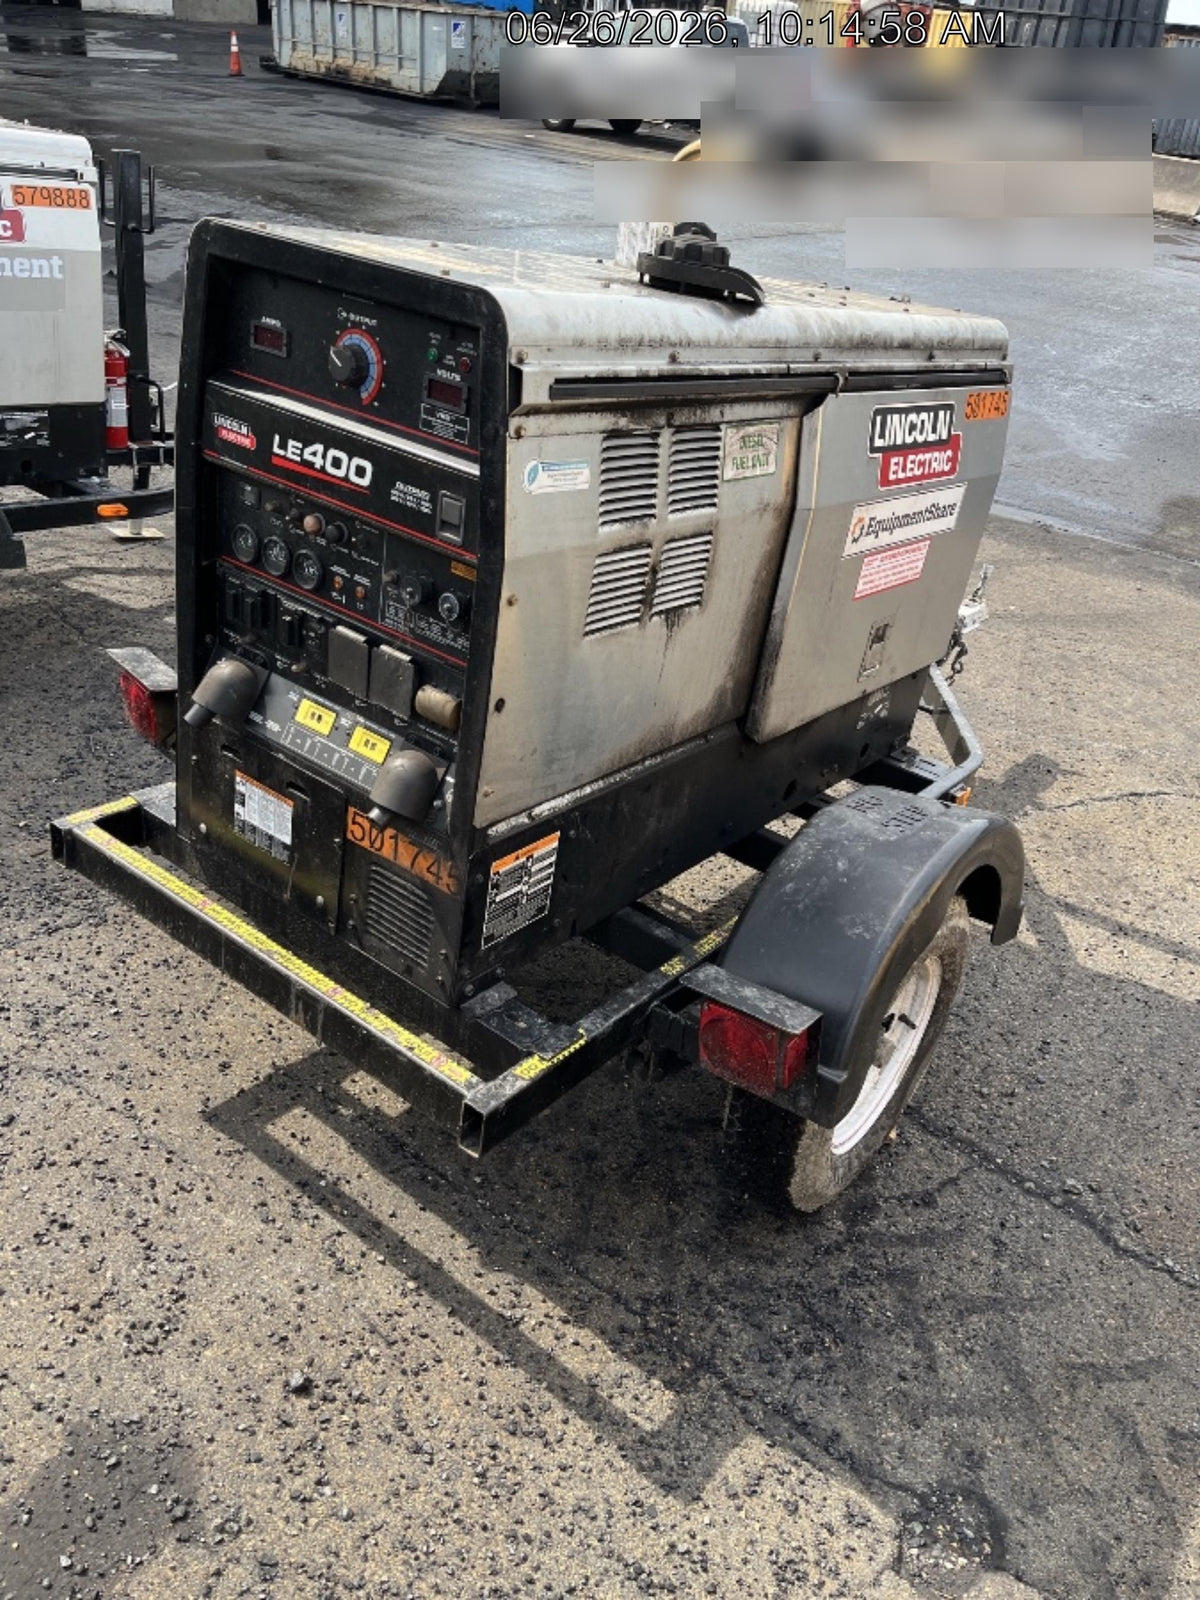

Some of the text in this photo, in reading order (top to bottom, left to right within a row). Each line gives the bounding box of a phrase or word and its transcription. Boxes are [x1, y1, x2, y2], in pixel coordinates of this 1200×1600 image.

[13, 185, 91, 209] 579888
[873, 410, 950, 447] LINCOLN
[272, 433, 373, 487] LE400
[888, 449, 953, 481] ELECTRIC
[865, 502, 958, 539] EquipmentShare
